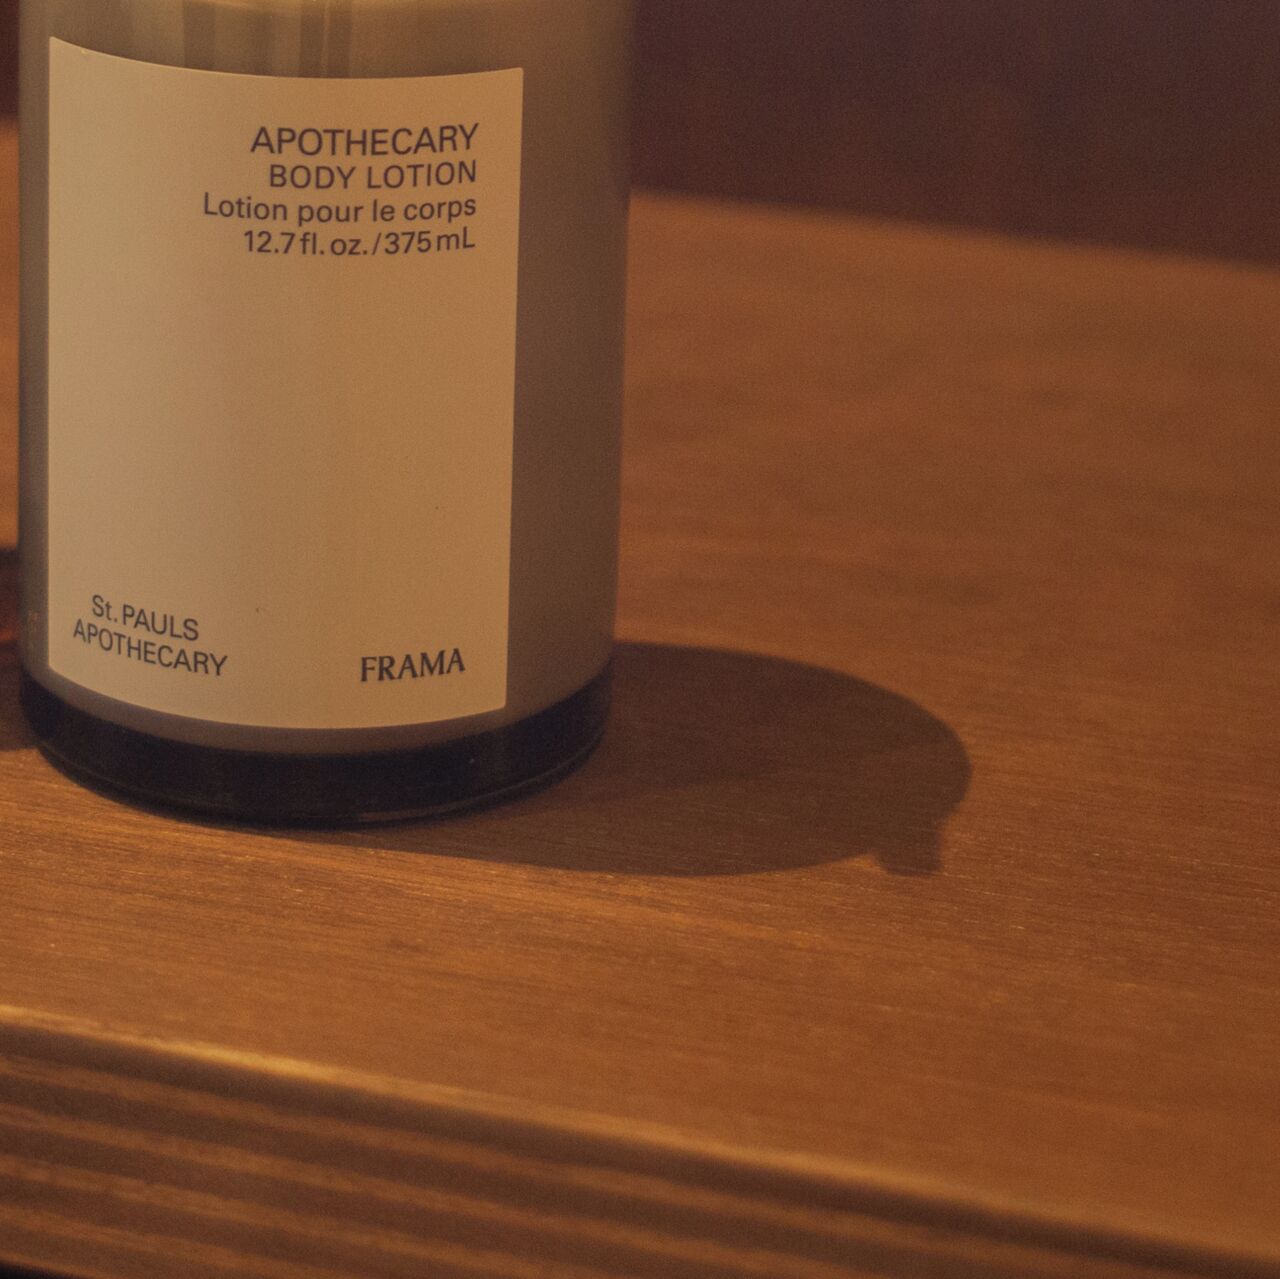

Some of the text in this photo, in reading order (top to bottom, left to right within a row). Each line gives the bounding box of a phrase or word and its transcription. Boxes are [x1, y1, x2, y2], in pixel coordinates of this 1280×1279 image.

[249, 122, 480, 157] APOTHECARY
[269, 159, 477, 190] BODY LOTION
[203, 191, 477, 228] Lotion pour le corps
[72, 616, 229, 677] APOTHECARY
[360, 647, 466, 683] FRAMA
